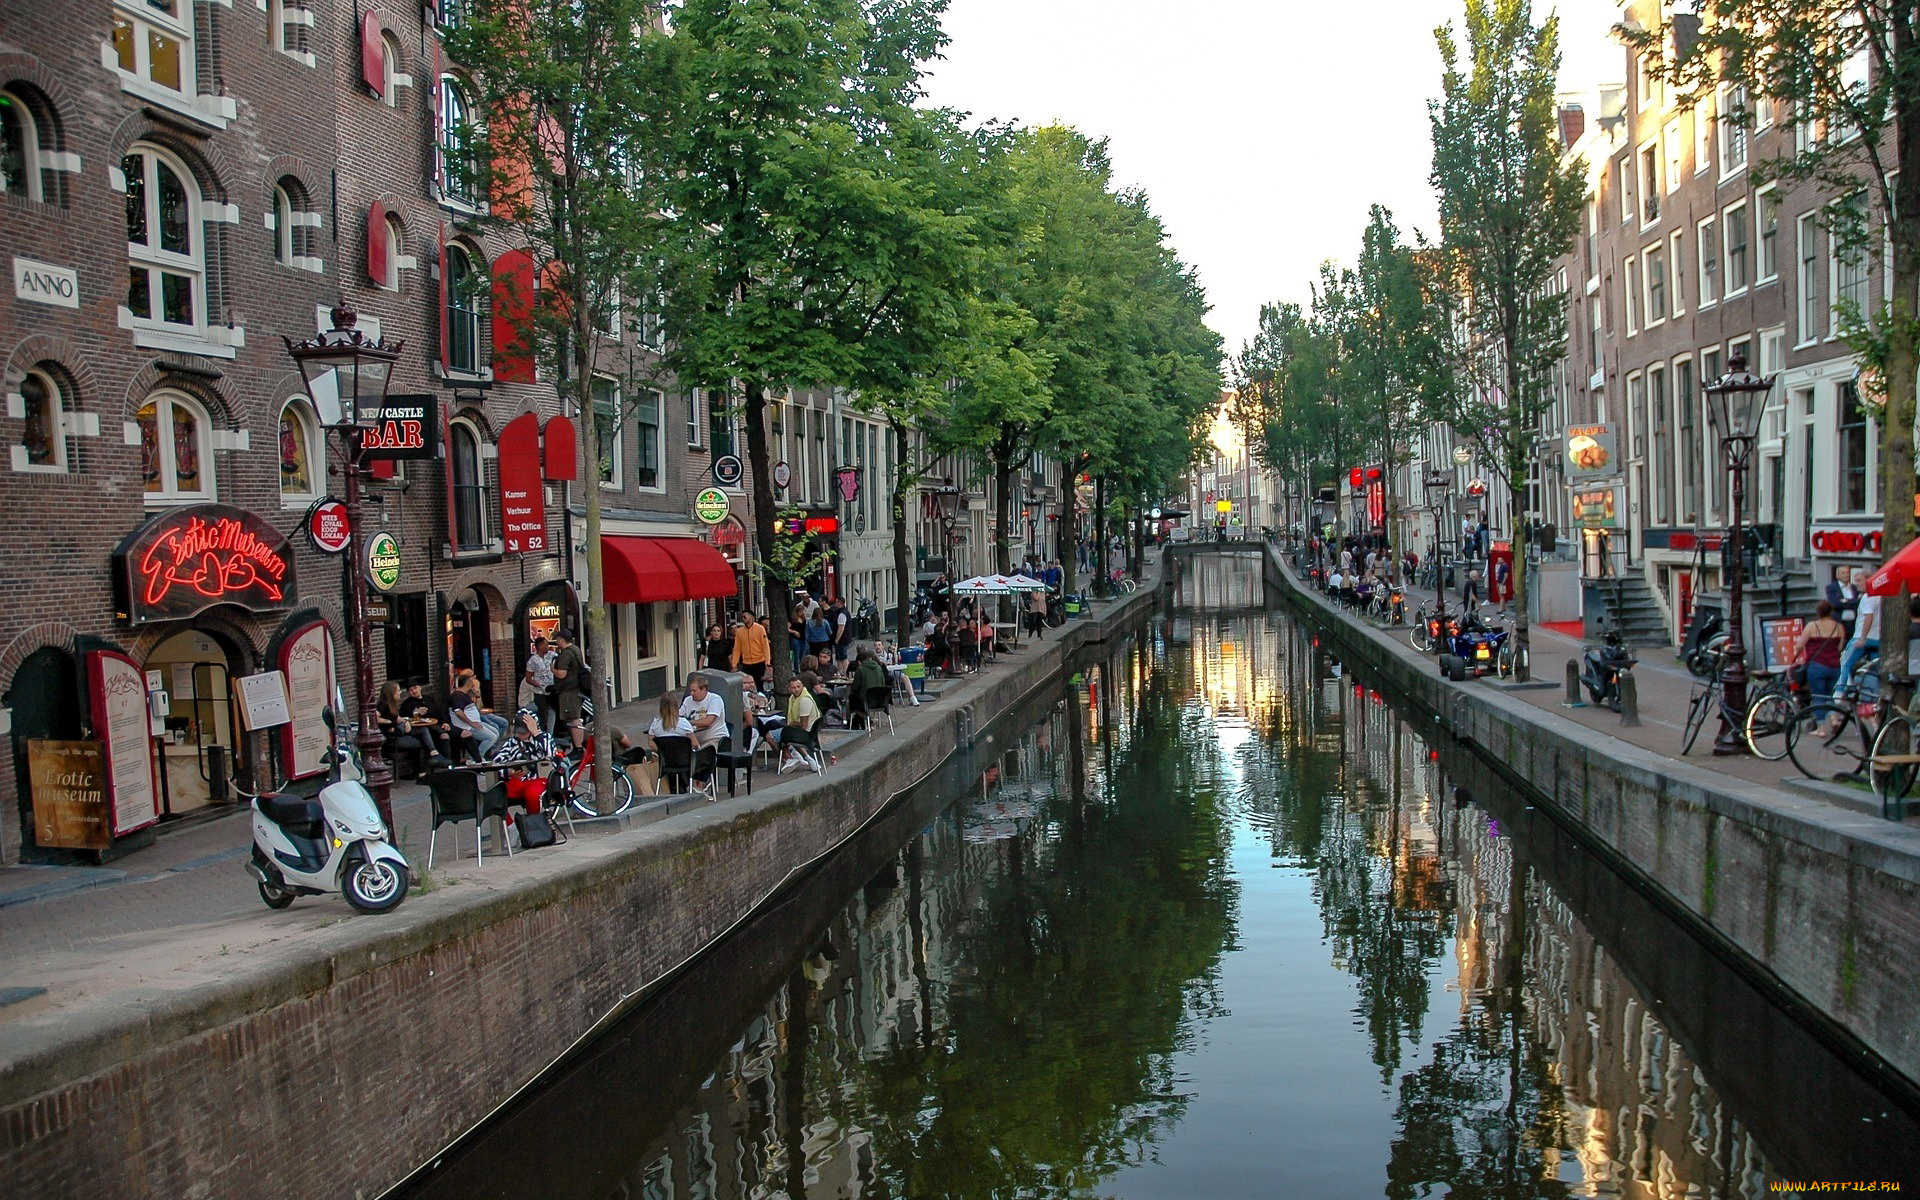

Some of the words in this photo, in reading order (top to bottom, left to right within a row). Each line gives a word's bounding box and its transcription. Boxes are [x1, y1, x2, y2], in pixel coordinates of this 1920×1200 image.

[21, 270, 73, 298] ANNO
[385, 407, 424, 418] CASTLE
[361, 420, 424, 449] BAR
[1569, 426, 1609, 436] FALAFEL
[505, 490, 527, 499] Kamer
[506, 507, 532, 515] Verhuur
[697, 502, 728, 510] Heineken
[521, 522, 541, 531] Office
[218, 517, 287, 581] Museum
[529, 536, 543, 549] 52
[45, 769, 93, 787] Erotic
[39, 788, 102, 803] museum
[44, 824, 54, 842] 5
